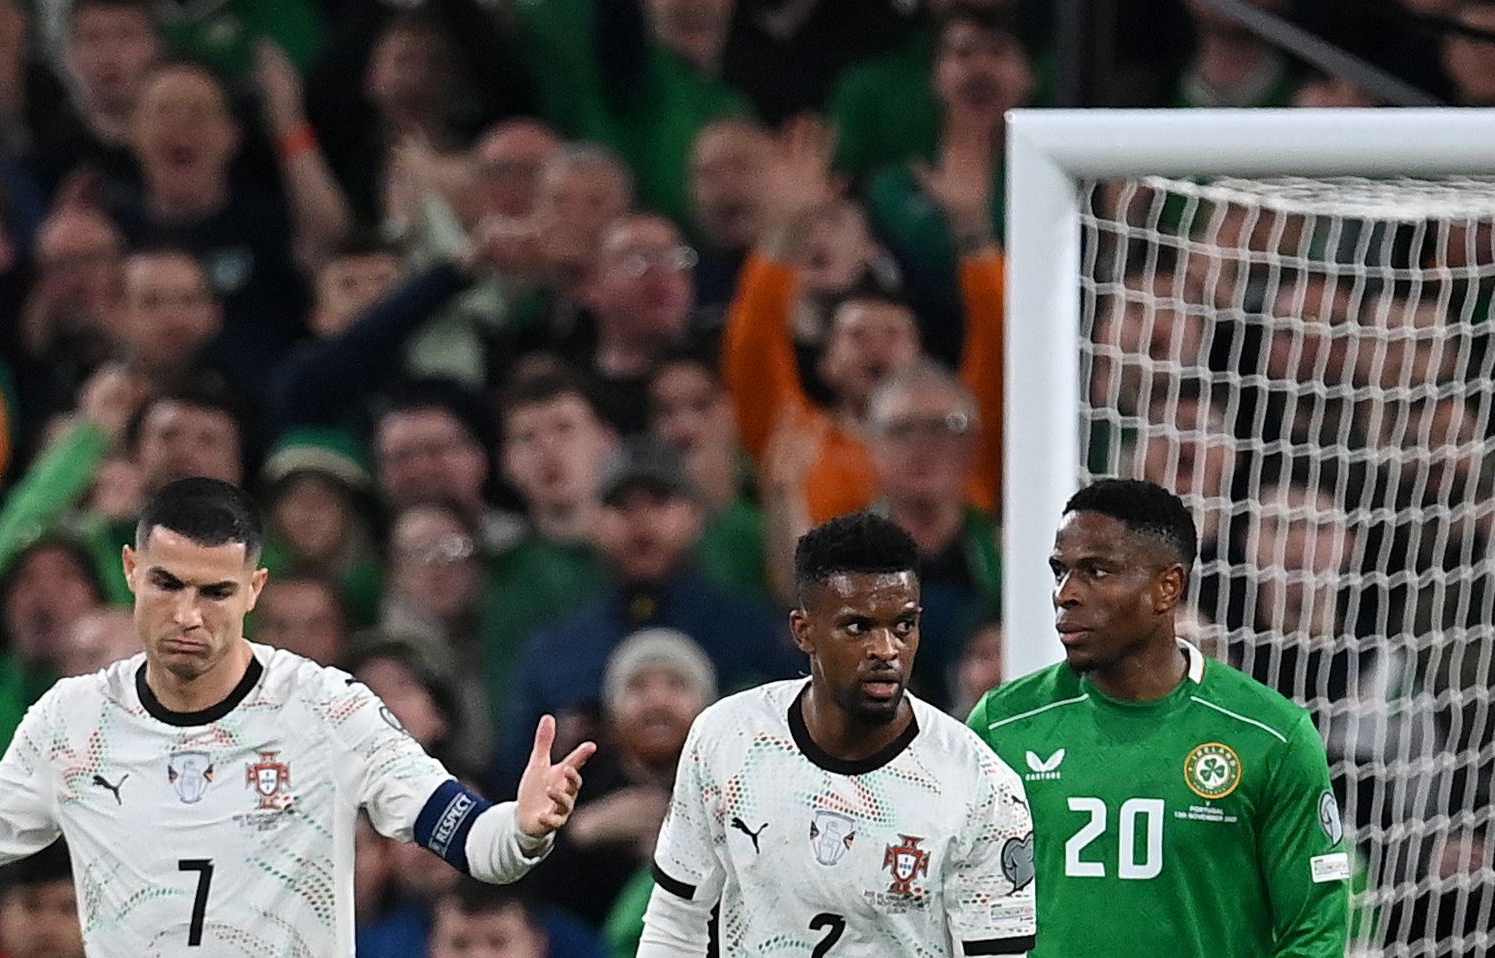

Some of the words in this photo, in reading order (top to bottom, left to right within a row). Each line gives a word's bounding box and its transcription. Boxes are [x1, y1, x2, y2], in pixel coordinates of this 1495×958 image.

[435, 794, 472, 844] RESPECT
[1065, 797, 1165, 880] 20
[178, 859, 213, 946] 7
